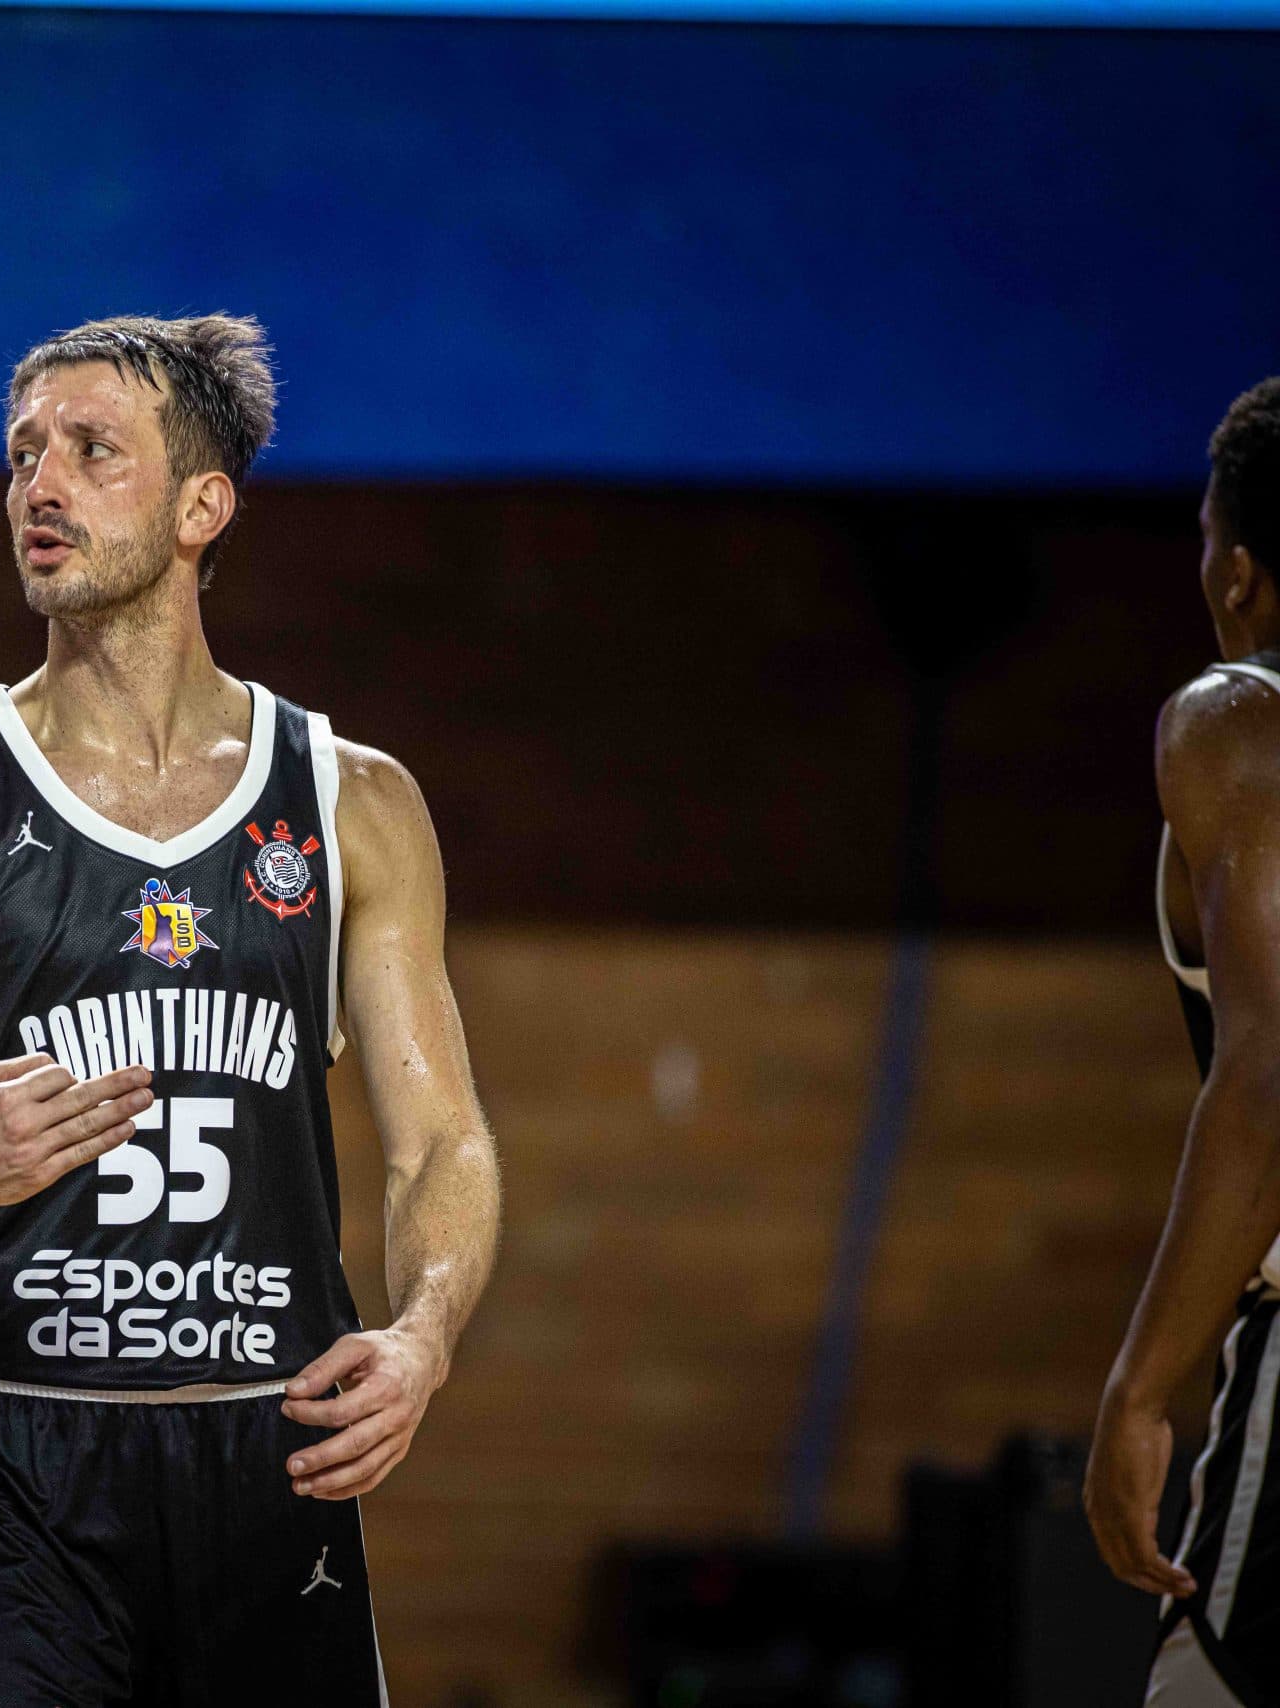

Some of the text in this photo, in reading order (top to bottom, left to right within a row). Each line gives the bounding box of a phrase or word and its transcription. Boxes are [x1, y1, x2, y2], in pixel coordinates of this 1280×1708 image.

[176, 909, 192, 948] LSB
[97, 1097, 234, 1225] 55
[13, 1249, 292, 1314] Esportes
